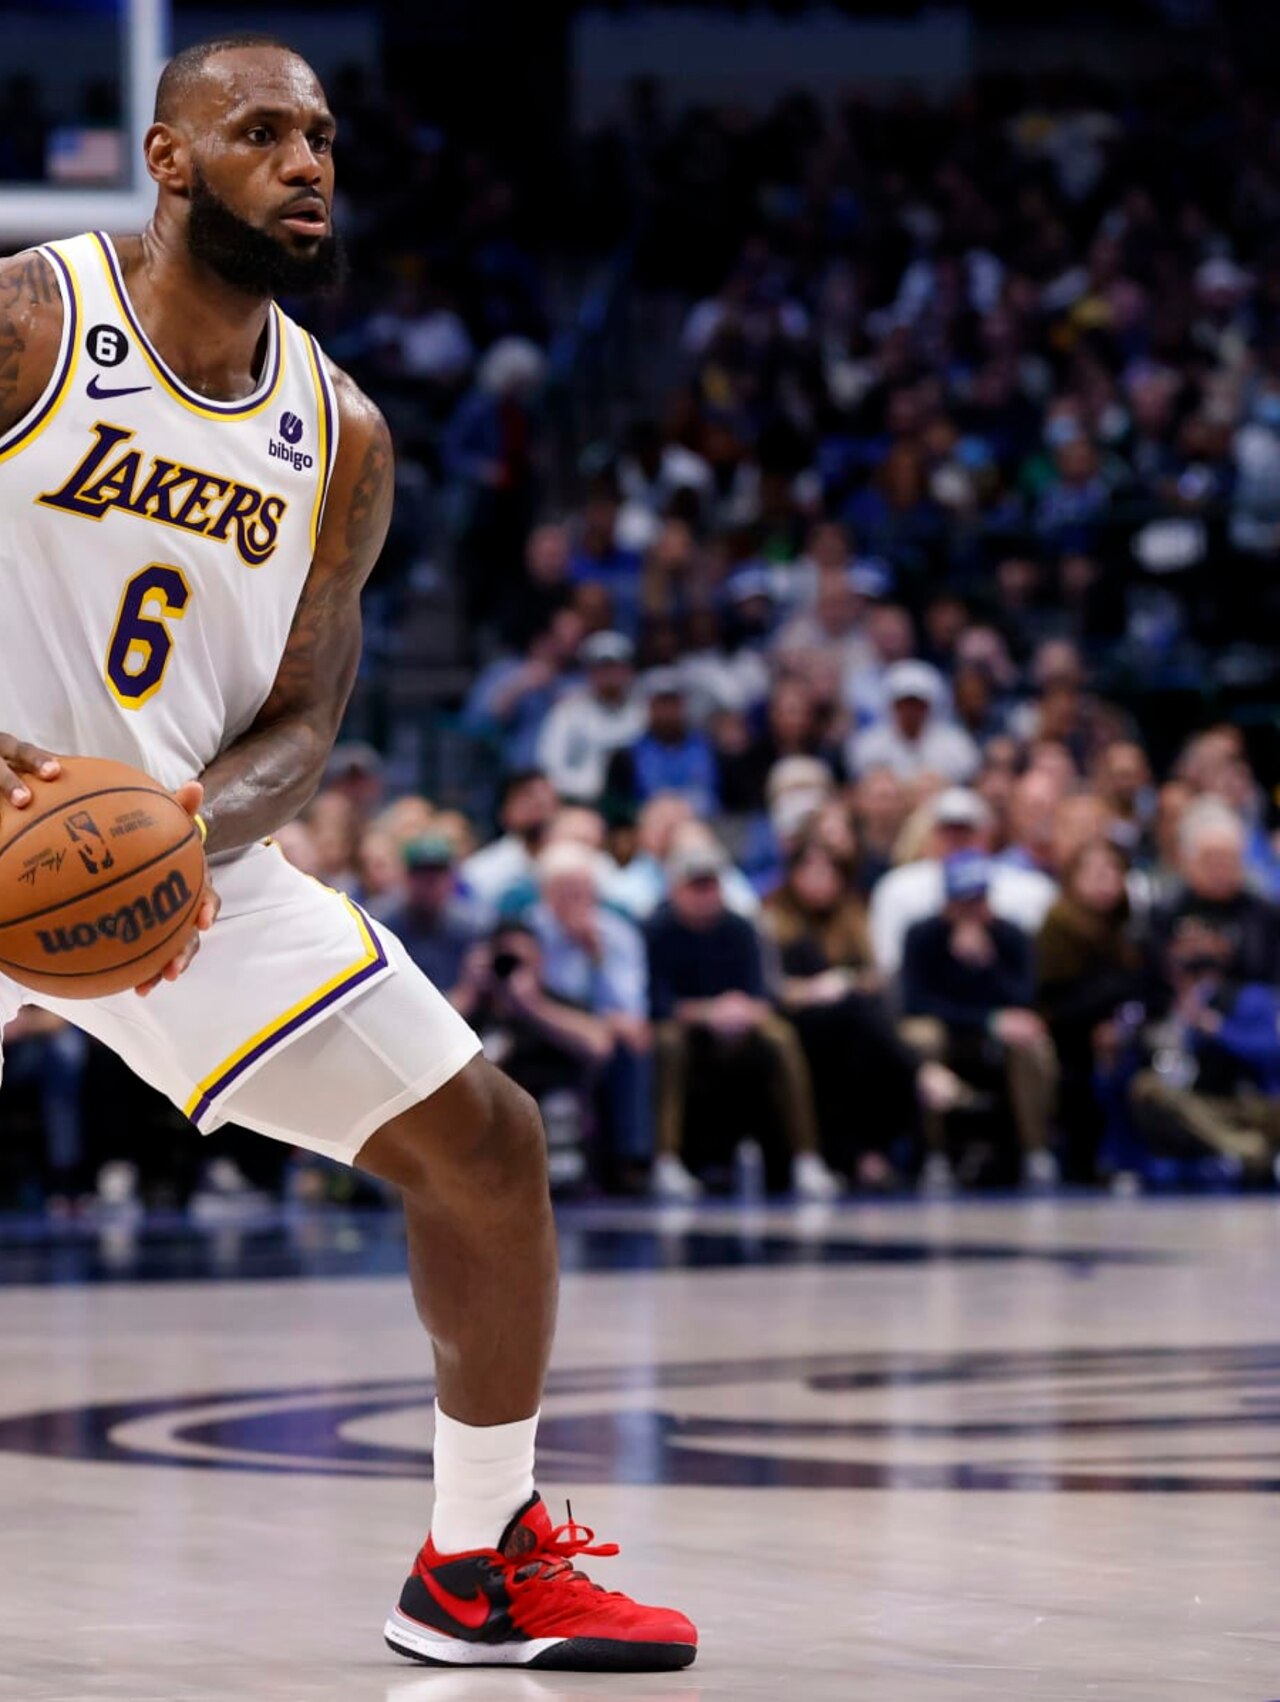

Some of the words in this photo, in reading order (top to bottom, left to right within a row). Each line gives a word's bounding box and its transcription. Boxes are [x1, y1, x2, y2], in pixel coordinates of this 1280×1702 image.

[95, 330, 118, 362] 6
[34, 420, 287, 568] LAKERS
[268, 437, 313, 471] bibigo
[104, 561, 193, 711] 6
[37, 869, 192, 954] Wilson
